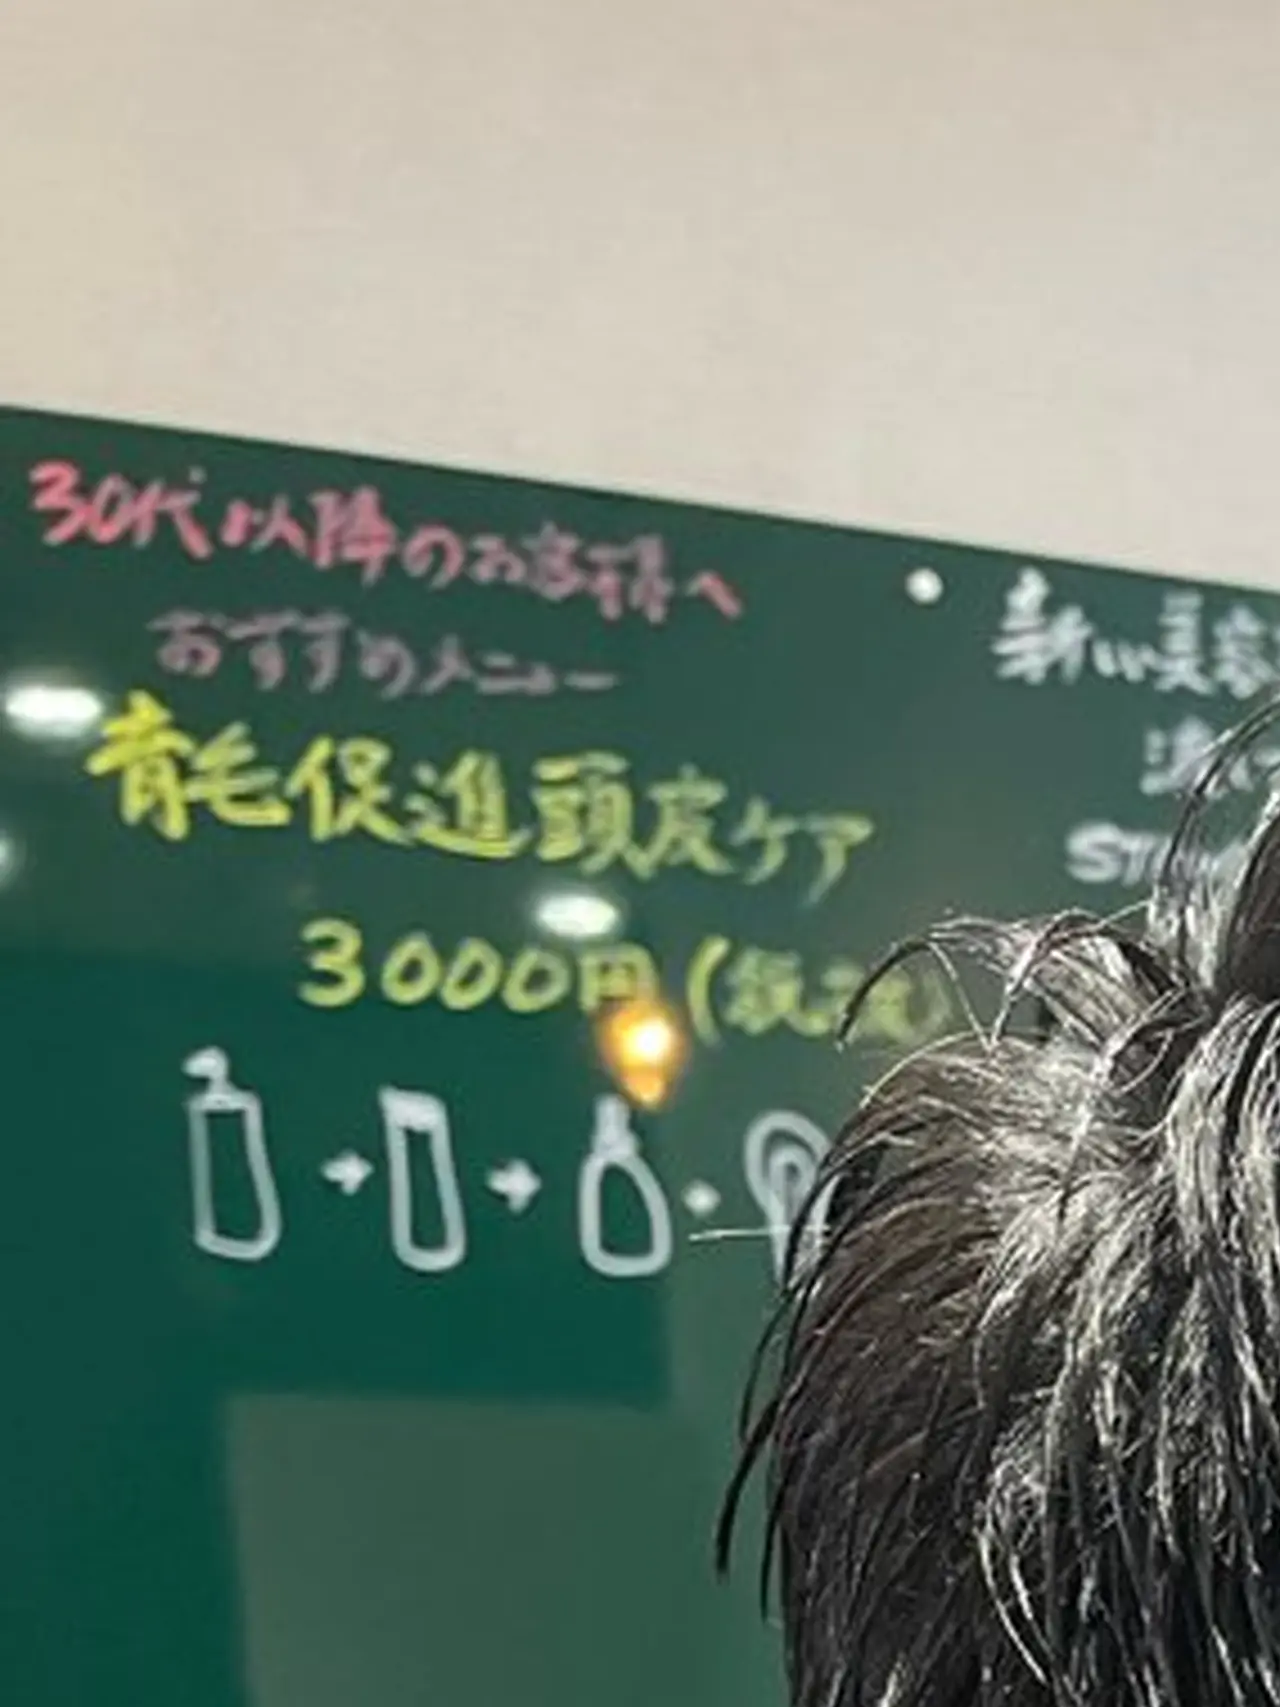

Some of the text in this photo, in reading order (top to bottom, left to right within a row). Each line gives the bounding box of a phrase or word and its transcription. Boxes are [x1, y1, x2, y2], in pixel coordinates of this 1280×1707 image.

[147, 608, 622, 697] おすすめメニュー
[84, 688, 876, 905] 育毛促進頭皮ケア
